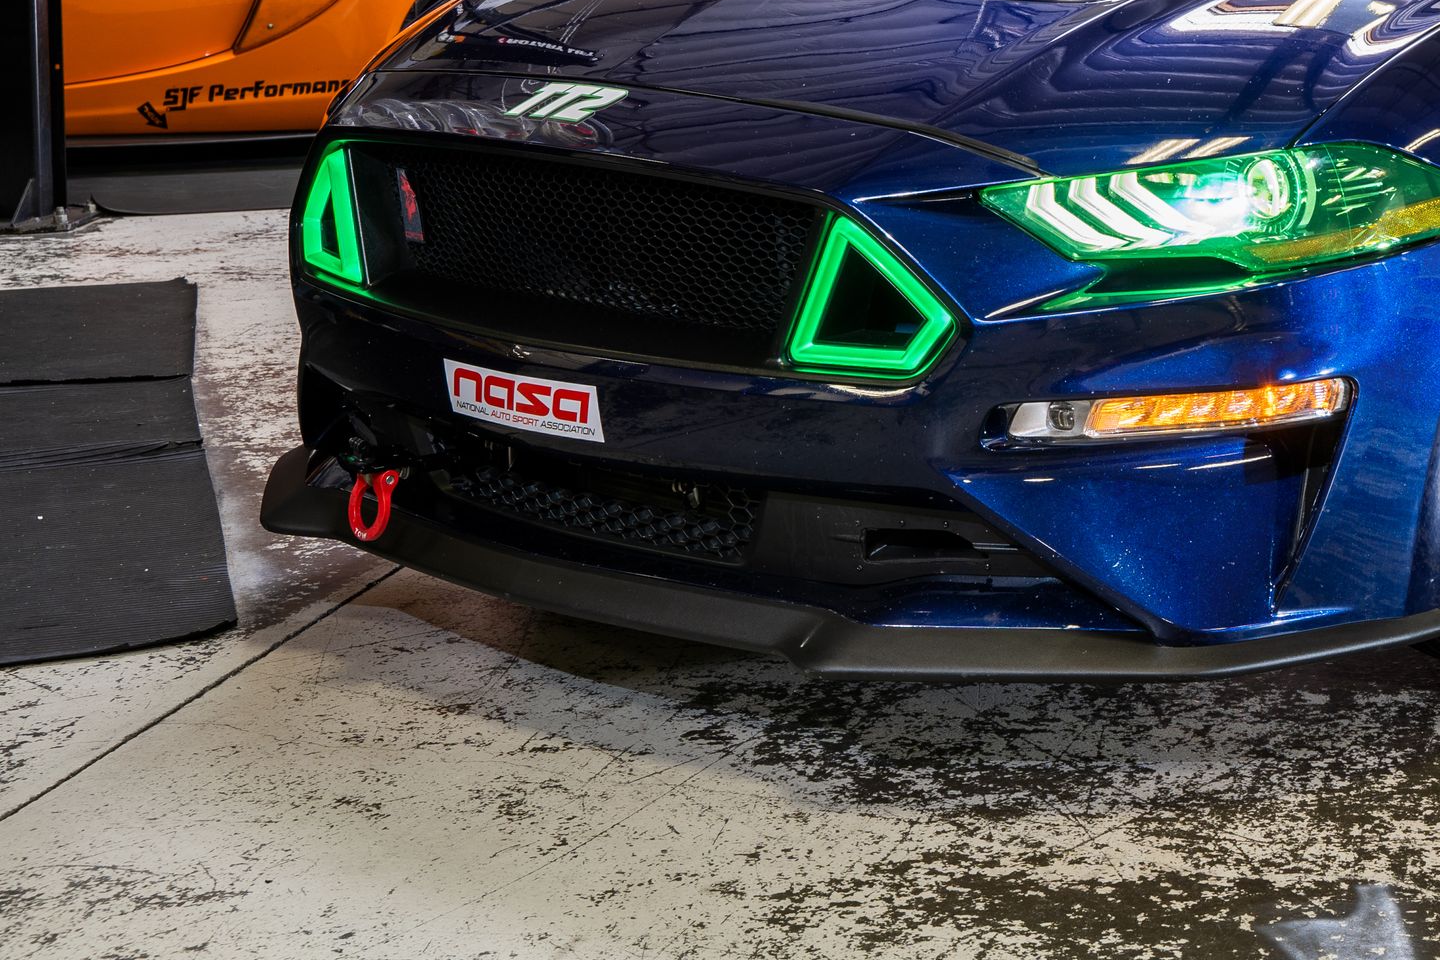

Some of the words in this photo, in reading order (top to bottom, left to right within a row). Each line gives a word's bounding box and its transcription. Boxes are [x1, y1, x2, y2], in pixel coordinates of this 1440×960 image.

[162, 85, 203, 112] SJF
[503, 81, 629, 124] TT2
[453, 367, 591, 424] nasa
[456, 399, 490, 416] NATIONAL
[490, 409, 511, 421] AUTO
[512, 415, 539, 427] SPORT
[540, 420, 596, 436] ASSOCIATION
